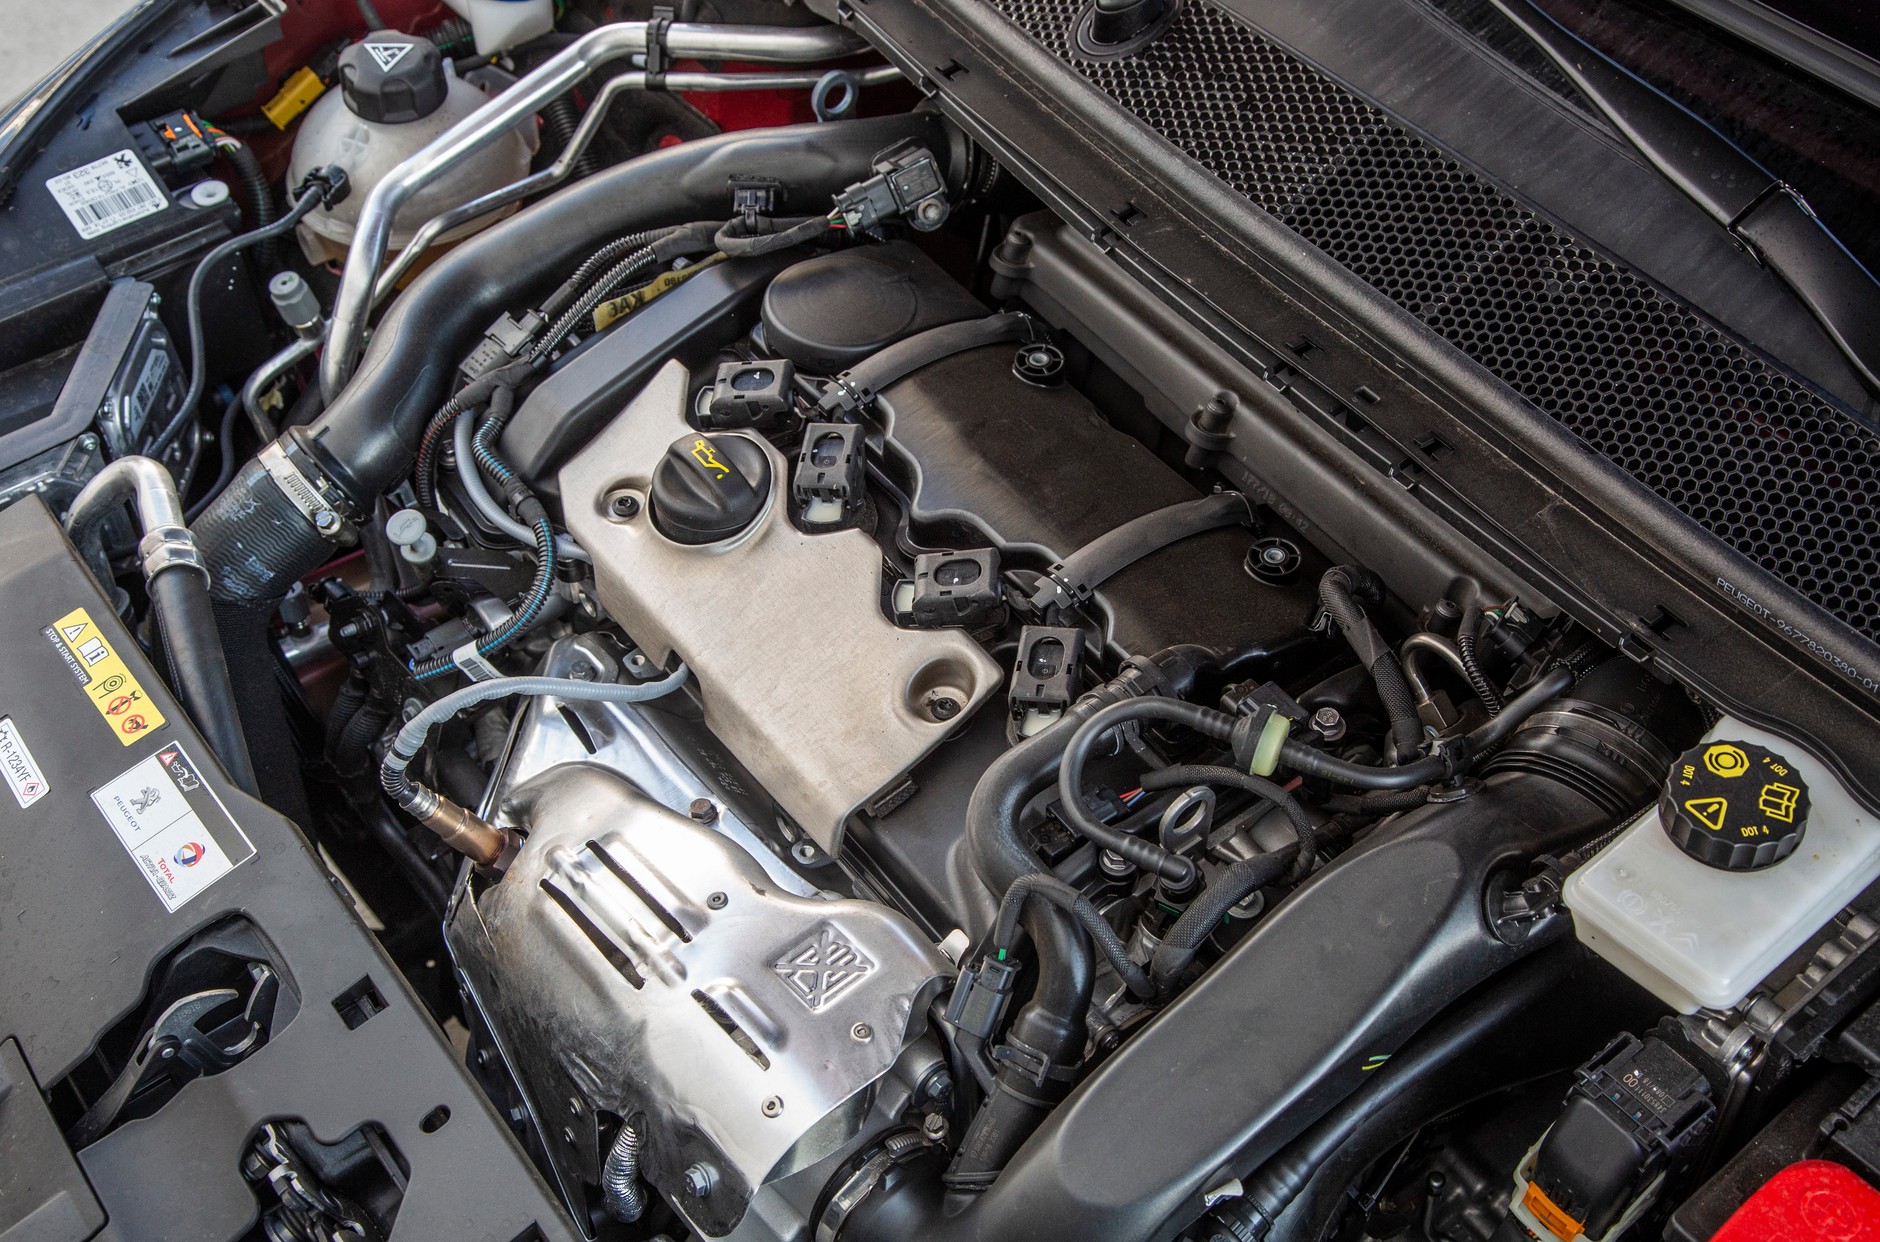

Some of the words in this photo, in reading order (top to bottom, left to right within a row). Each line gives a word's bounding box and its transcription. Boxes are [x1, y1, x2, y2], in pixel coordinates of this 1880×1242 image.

[72, 167, 90, 178] 323
[44, 628, 60, 645] STOP
[57, 645, 74, 665] START
[70, 661, 89, 684] SYSTEM
[0, 741, 31, 783] R-1234YF
[1682, 764, 1695, 779] DOT
[1769, 763, 1788, 776] DOT
[112, 794, 141, 833] PEUGEOT
[1740, 826, 1758, 837] DOT
[1762, 825, 1770, 834] 4
[157, 857, 175, 883] TOTAL
